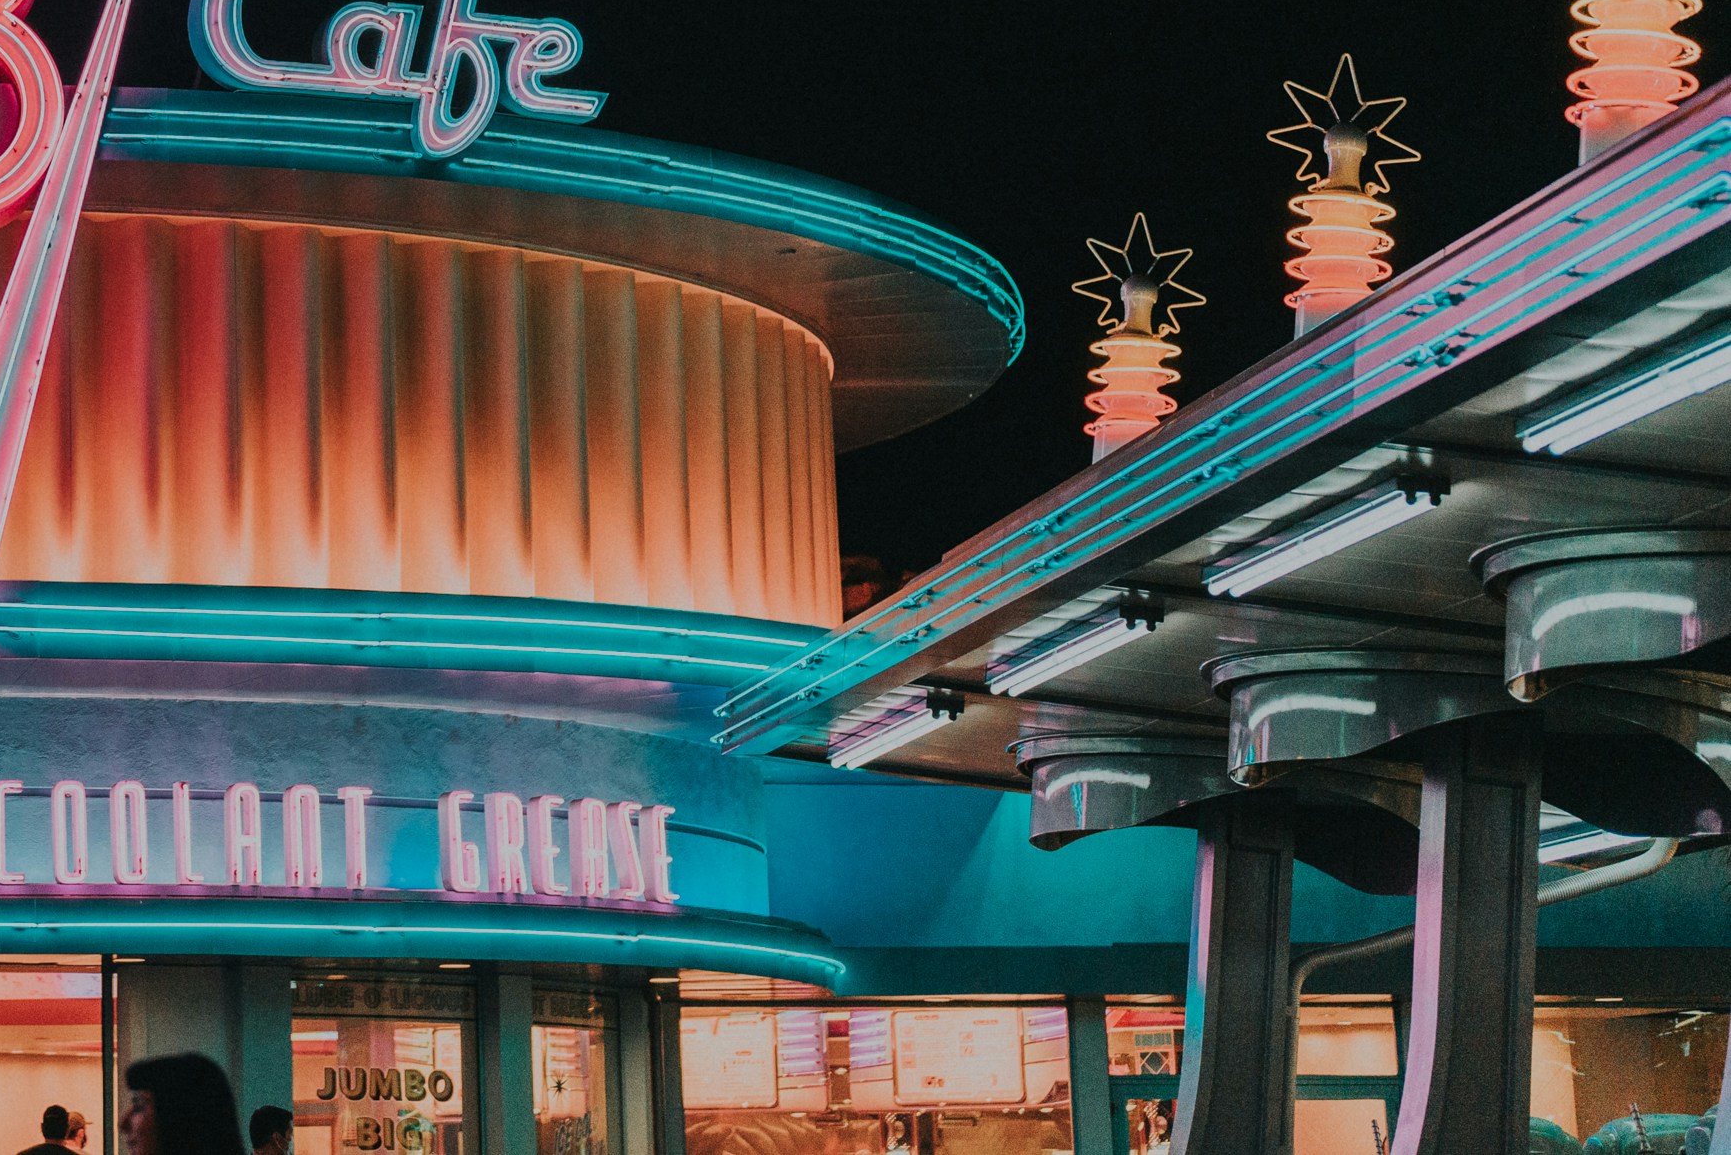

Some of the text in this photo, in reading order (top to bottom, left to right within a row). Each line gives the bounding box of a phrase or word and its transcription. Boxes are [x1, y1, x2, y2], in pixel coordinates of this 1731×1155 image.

[438, 790, 681, 904] GREASE
[316, 1066, 454, 1102] JUMBO
[355, 1116, 426, 1151] BIG
